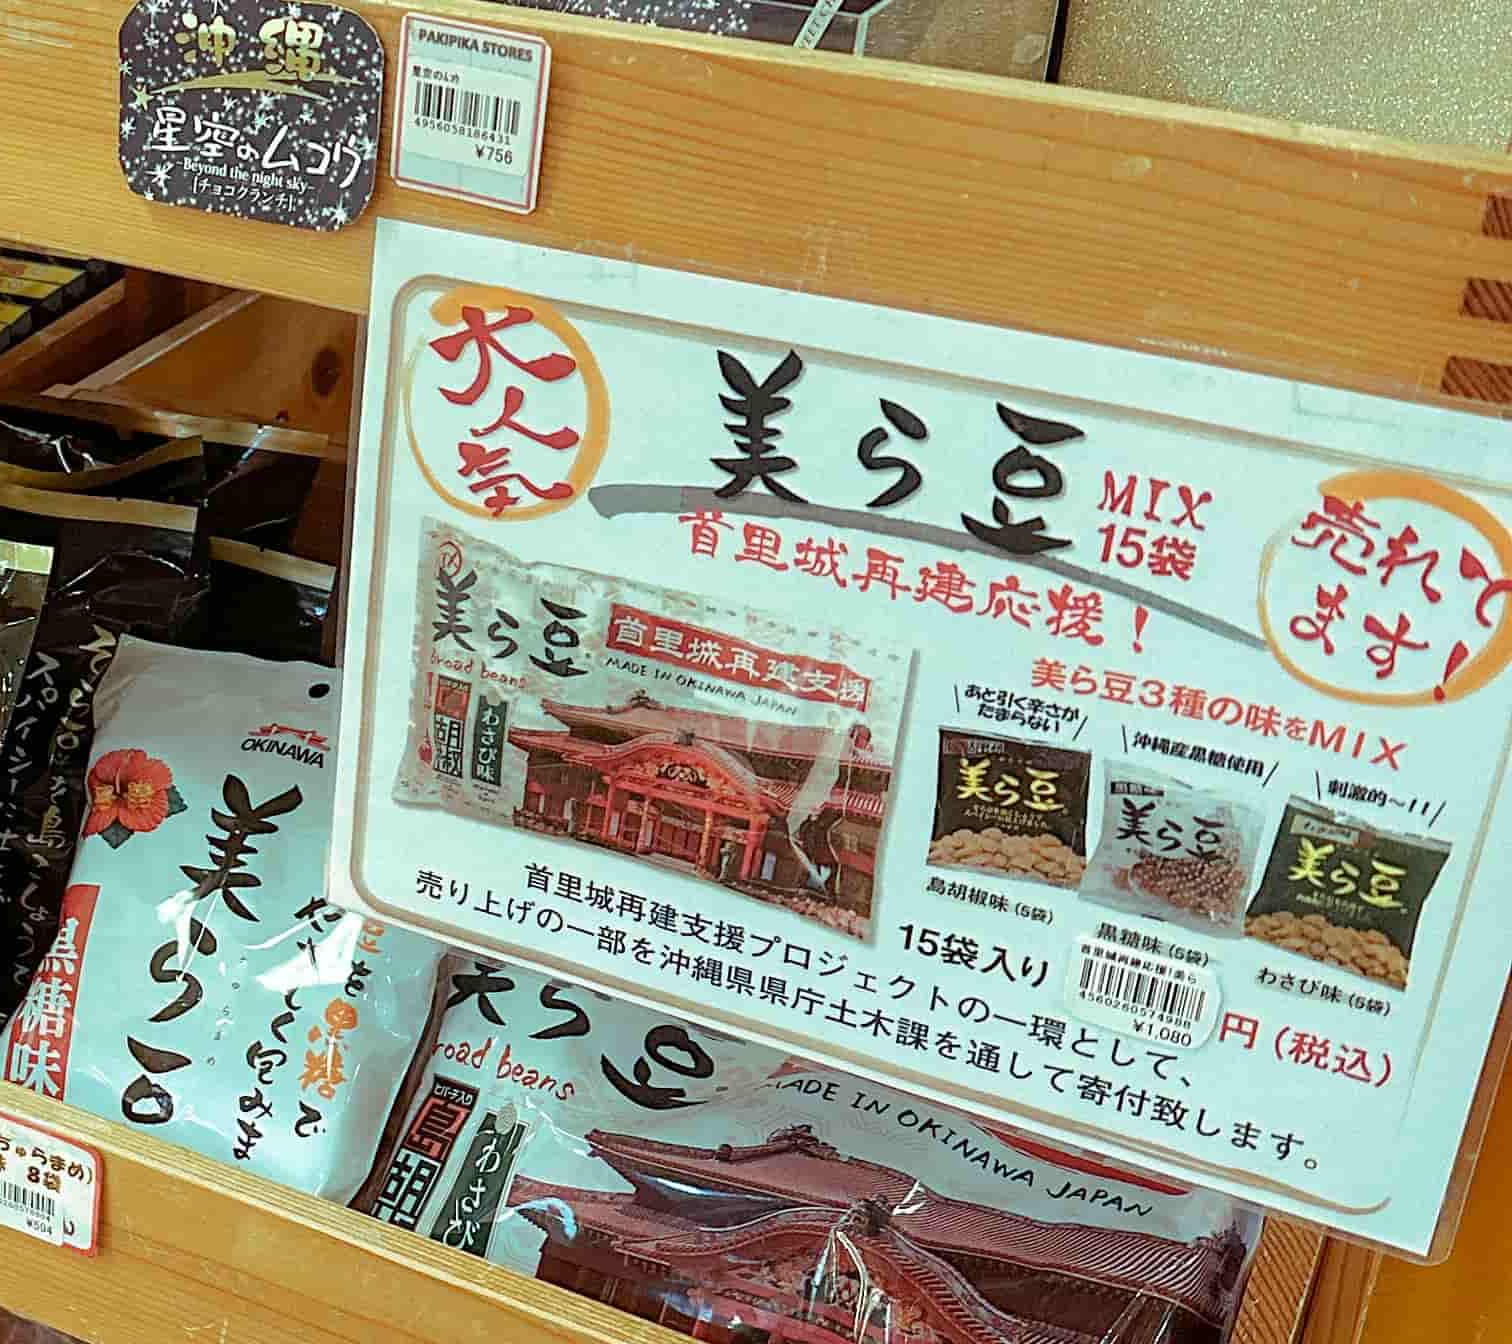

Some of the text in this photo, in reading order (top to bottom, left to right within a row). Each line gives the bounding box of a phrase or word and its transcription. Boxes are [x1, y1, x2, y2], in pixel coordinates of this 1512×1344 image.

[175, 14, 325, 82] 沖縄
[419, 29, 533, 63] PAKIPIKA STORES
[150, 105, 363, 188] 星空のムコウ
[229, 164, 248, 179] the
[251, 170, 284, 191] night
[475, 144, 513, 165] ¥756
[428, 304, 578, 518] 大人気
[710, 348, 1085, 556] 美ら豆
[1097, 469, 1213, 530] MIX
[1097, 523, 1198, 580] 15袋
[433, 568, 588, 677] 美ら豆
[605, 655, 798, 719] MADE IN OKINAWA JAPAN
[1031, 657, 1407, 771] 美ら豆3種の味をMIX
[240, 735, 325, 769] OKINAWA
[957, 758, 1065, 812] 美ら豆
[1116, 797, 1225, 864] 美ら豆
[1288, 836, 1407, 909] 美ら豆
[897, 923, 1050, 988] 15袋入り
[1257, 967, 1343, 1002] わさび味
[9, 916, 79, 1100] 黒糖味
[1133, 1019, 1192, 1048] ¥1,080
[430, 1039, 576, 1103] road beans
[775, 1078, 1153, 1218] ADE IN OKINAWA JAPAN
